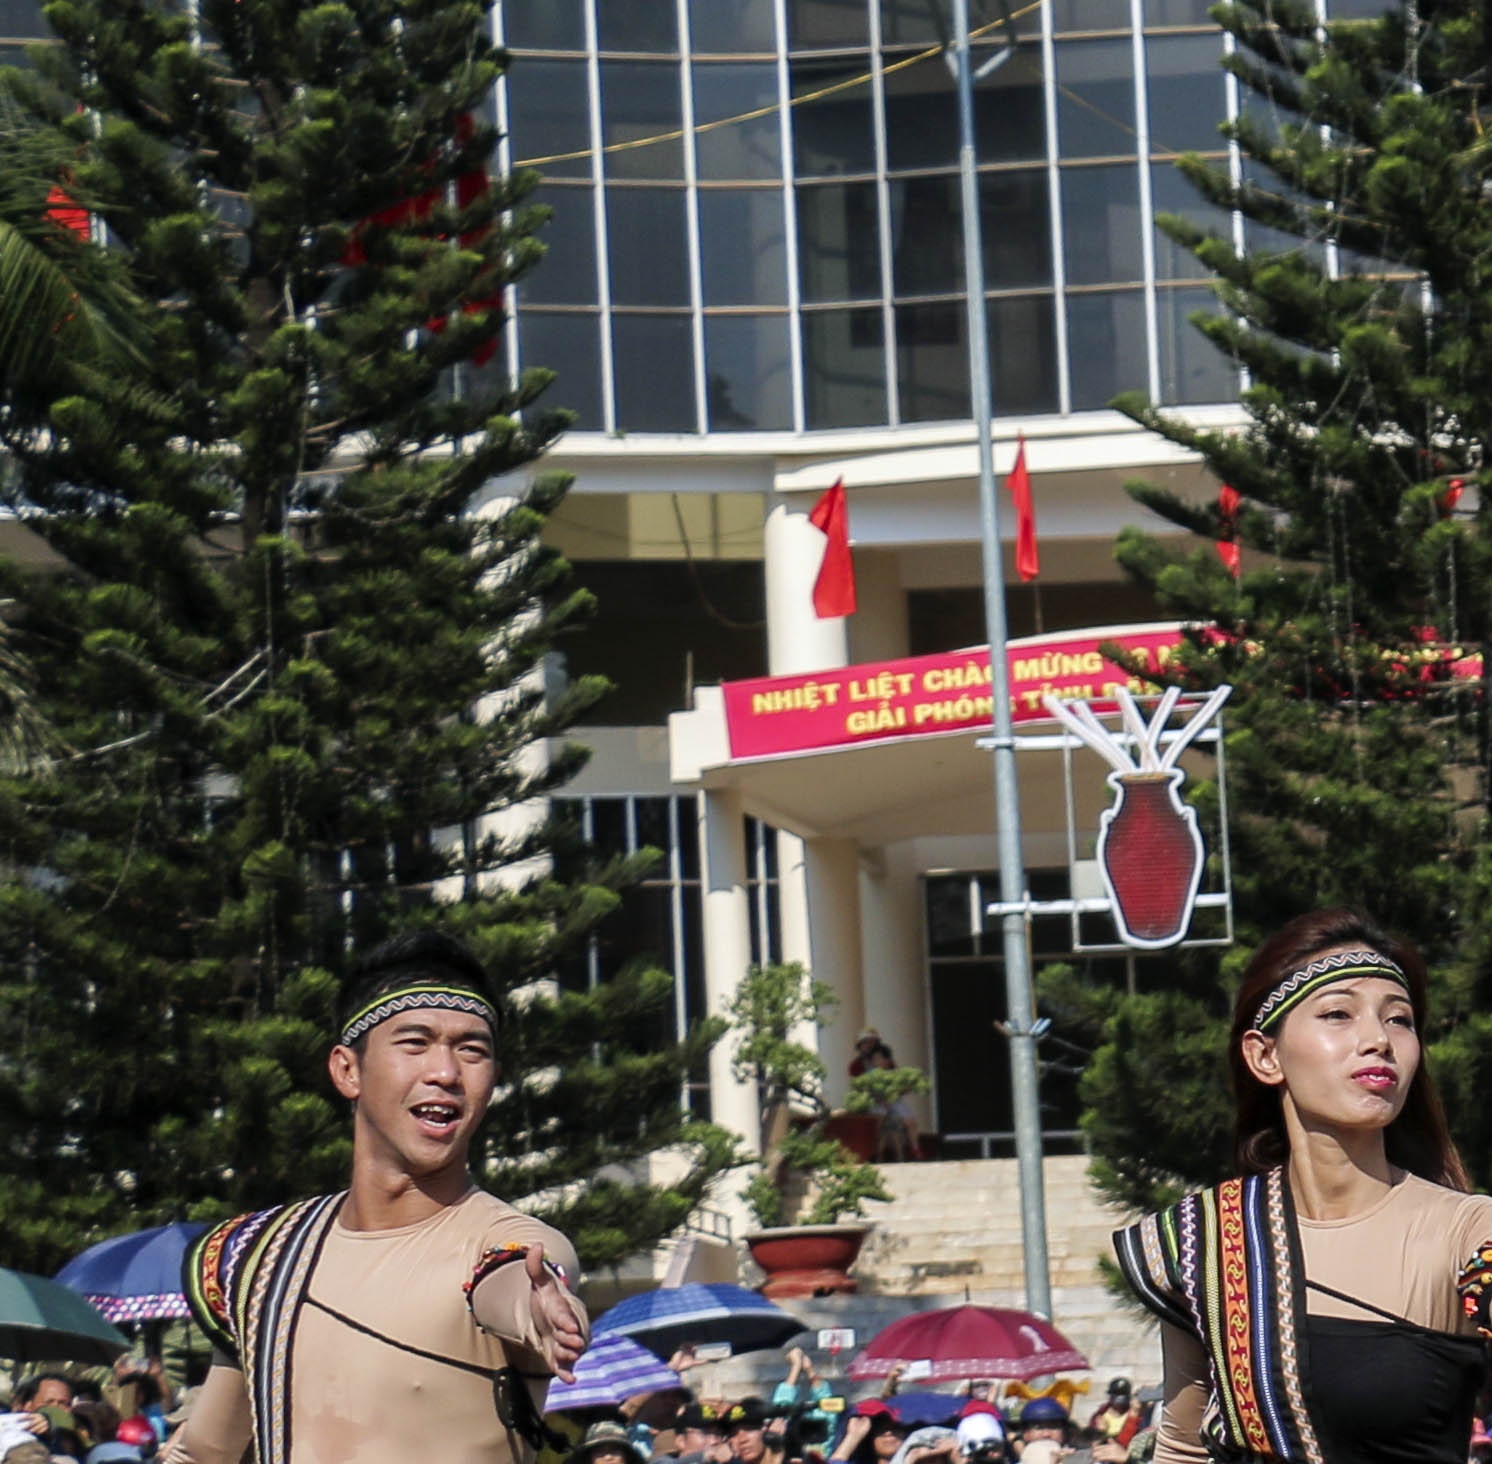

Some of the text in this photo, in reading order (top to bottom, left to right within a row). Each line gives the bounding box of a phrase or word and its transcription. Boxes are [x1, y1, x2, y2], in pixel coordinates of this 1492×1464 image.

[753, 682, 842, 714] NHIỆT
[849, 670, 916, 701] LIỆT
[1013, 651, 1103, 682] MỪNG
[846, 703, 905, 736] GIẢI
